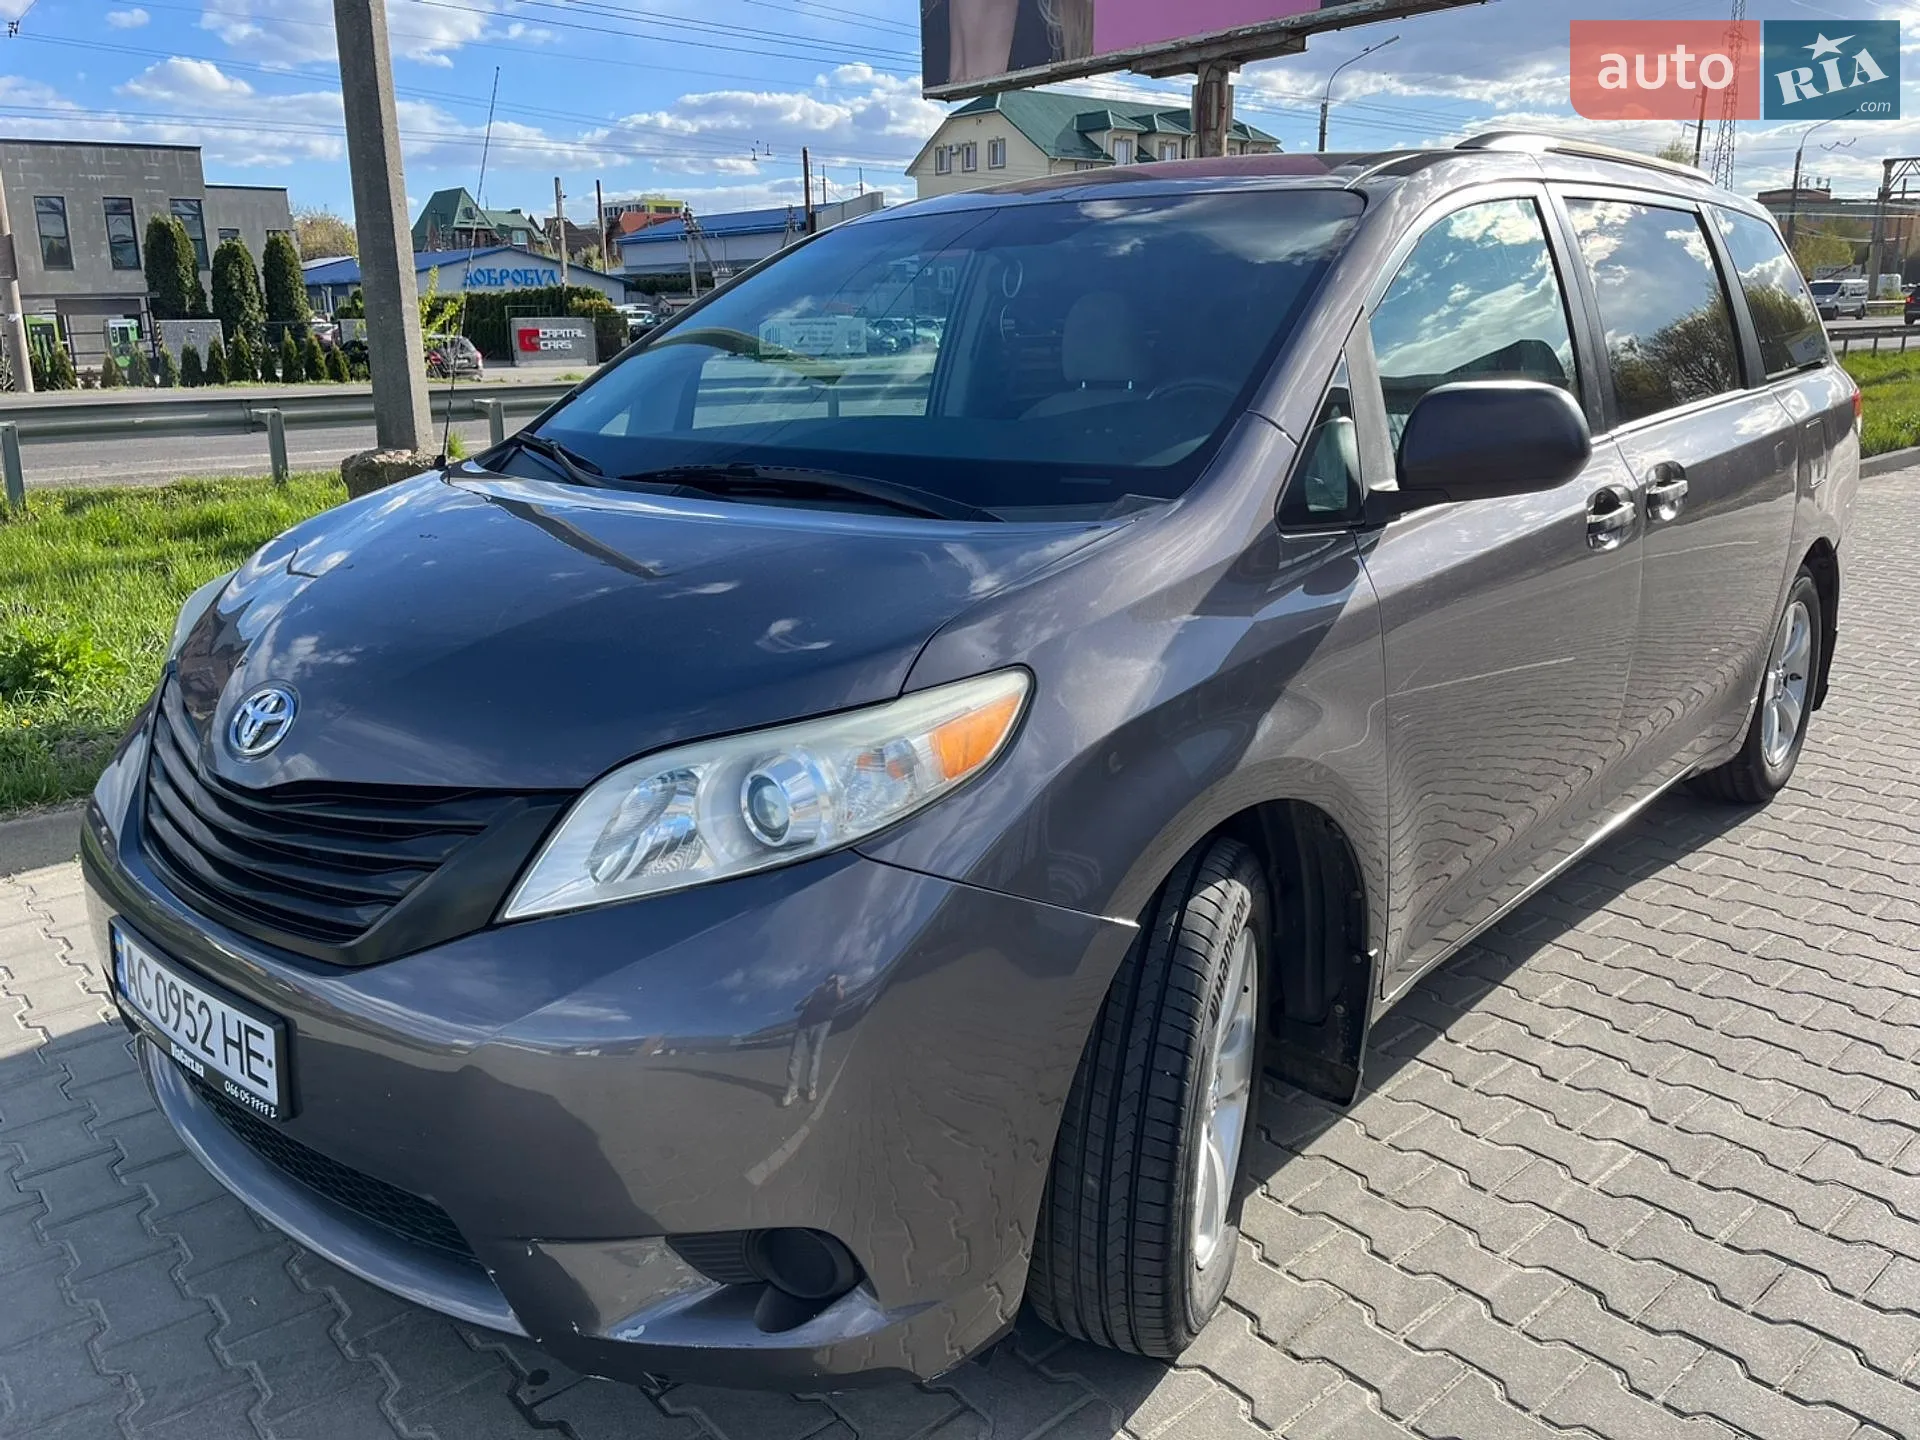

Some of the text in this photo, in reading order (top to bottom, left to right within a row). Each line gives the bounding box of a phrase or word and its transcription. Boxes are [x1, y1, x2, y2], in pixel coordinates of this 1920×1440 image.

[539, 328, 586, 338] CAPITAL
[540, 340, 572, 350] CARS
[155, 971, 215, 1059] 0952
[221, 1011, 269, 1089] HE
